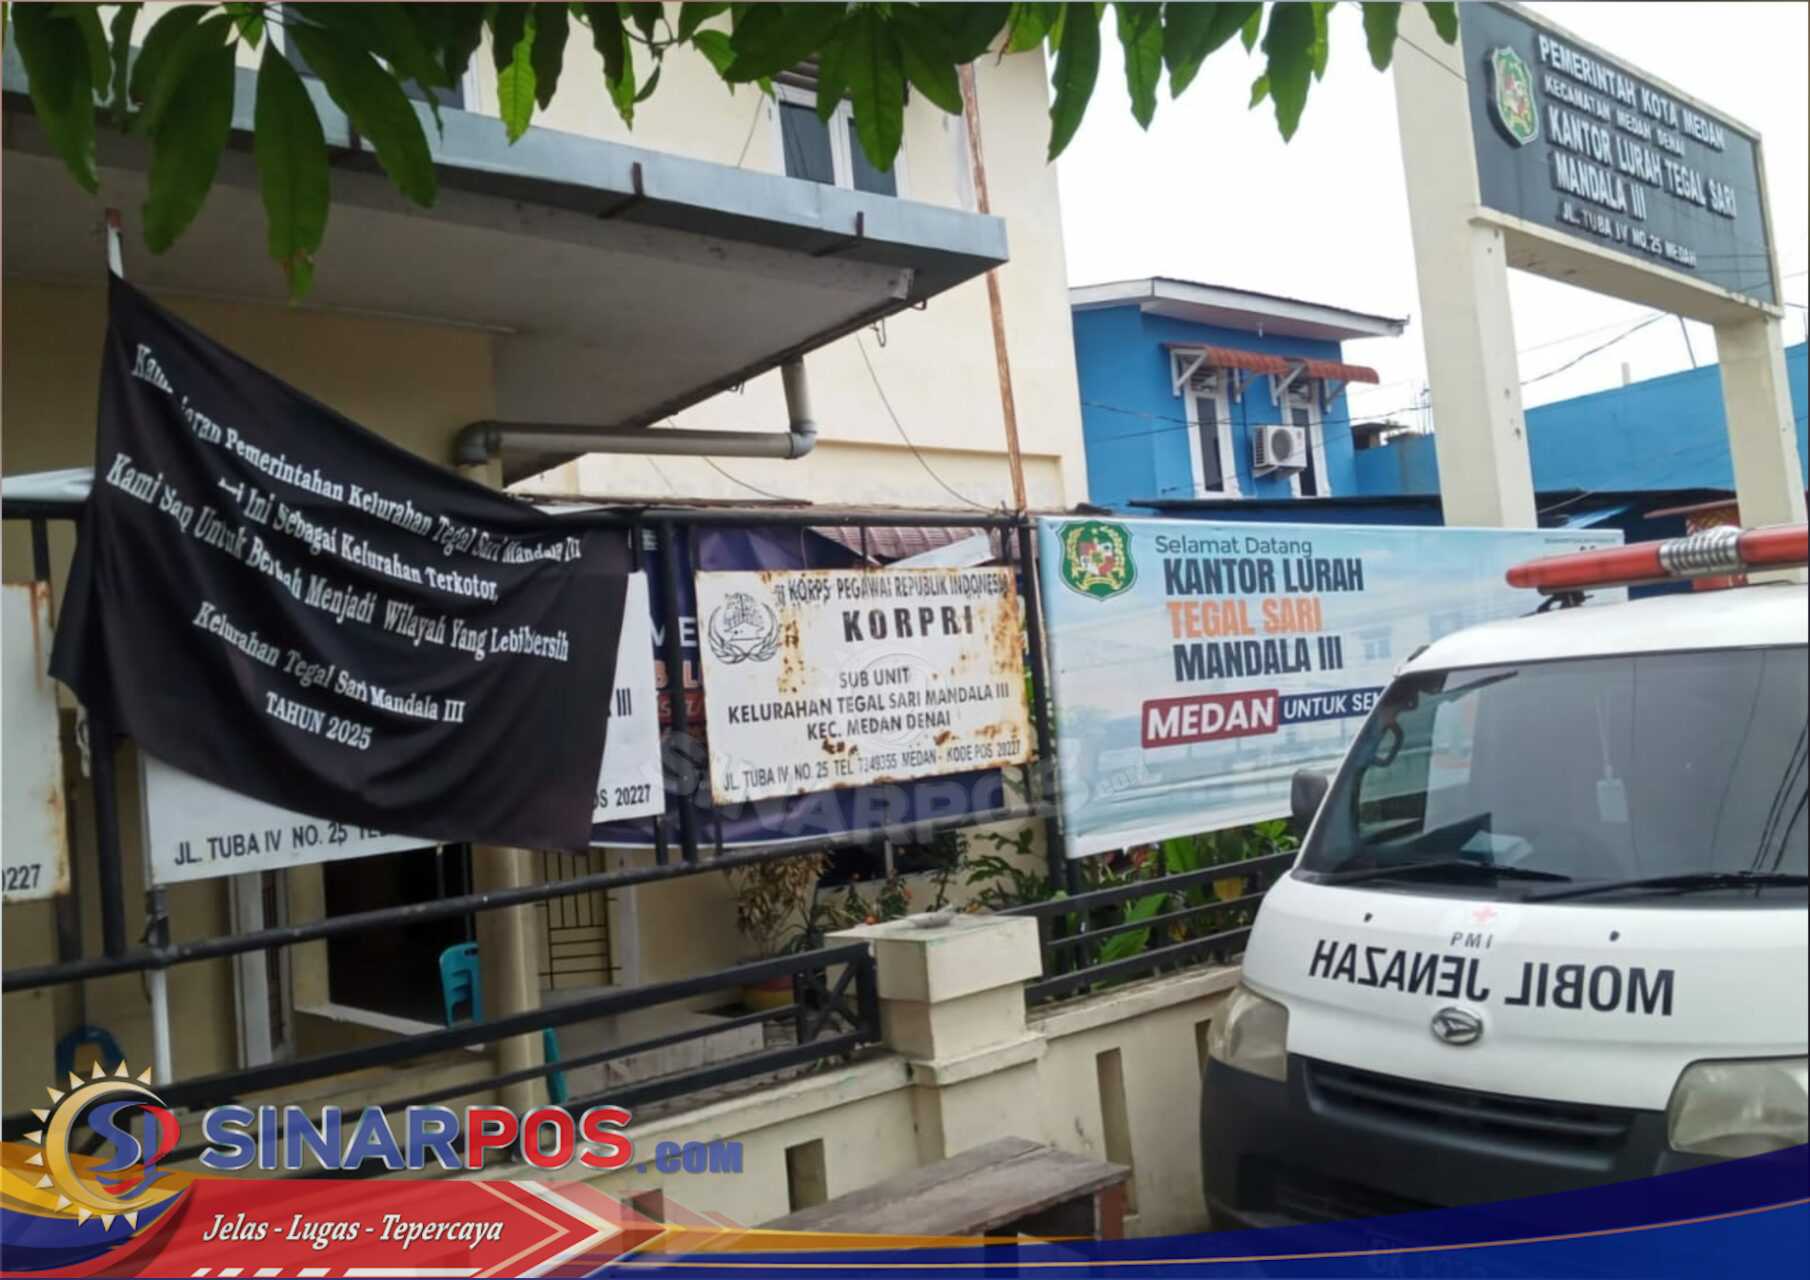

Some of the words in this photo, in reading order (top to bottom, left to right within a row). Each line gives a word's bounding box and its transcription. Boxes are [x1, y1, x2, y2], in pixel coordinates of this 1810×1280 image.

[1539, 34, 1636, 107] PEMERINTAH
[1640, 87, 1678, 129] KOTA
[1682, 109, 1725, 151] MEDAN
[1544, 75, 1611, 122] KECAMATAN
[1616, 110, 1650, 141] MEDAN
[1656, 128, 1685, 158] DENAI
[1549, 105, 1613, 167] KANTOR
[1616, 136, 1662, 188] LURAH
[1664, 159, 1706, 208] TEGAL
[1708, 178, 1736, 218] SARI
[1555, 152, 1627, 211] MANDALA
[1630, 183, 1647, 220] III
[1582, 210, 1612, 236] TUBA
[1650, 235, 1663, 255] 25
[1664, 241, 1696, 266] MEDAN
[225, 427, 344, 502] Pemerintahan
[348, 484, 434, 536] Kelurahan
[432, 516, 477, 556] Tegal
[106, 453, 164, 504] Kami
[304, 574, 378, 624] Menjadi
[383, 599, 447, 646] Wilayah
[450, 617, 488, 661] Yang
[244, 489, 275, 534] Ini
[272, 502, 338, 556] Sebagai
[341, 533, 423, 584] Kelurahan
[424, 566, 499, 604] Terkotor,
[1155, 536, 1240, 554] Selamat
[1246, 537, 1312, 559] Datang
[837, 577, 892, 601] PEGAWAI
[894, 575, 948, 597] REPUBLIK
[1163, 558, 1275, 595] KANTOR
[1283, 557, 1364, 593] LURAH
[842, 605, 974, 642] KORPRI
[1166, 598, 1255, 639] TEGAL
[1262, 596, 1323, 635] SARI
[193, 601, 280, 667] Kelurahan
[283, 649, 336, 688] Tegal
[369, 684, 439, 721] Mandala
[442, 700, 466, 723] III
[840, 671, 868, 688] SUB
[873, 667, 911, 686] UNIT
[1173, 637, 1311, 682] MANDALA
[1317, 635, 1343, 670] III
[266, 691, 324, 734] TAHUN
[326, 717, 373, 750] 2025
[616, 686, 632, 717] III
[728, 698, 833, 724] KELURAHAN
[837, 693, 885, 714] TEGAL
[889, 690, 921, 709] SARI
[924, 684, 993, 705] MANDALA
[996, 683, 1009, 699] III
[1147, 696, 1275, 740] MEDAN
[1284, 694, 1347, 719] UNTUK
[806, 722, 842, 741] KEC.
[846, 716, 902, 735] MEDAN
[907, 711, 951, 729] DENAI
[743, 768, 775, 788] TUBA
[777, 765, 789, 783] IV
[816, 760, 829, 779] 25
[902, 750, 937, 769] MEDAN
[947, 744, 974, 762] KODE
[977, 742, 994, 759] POS
[616, 784, 651, 807] 20227
[175, 841, 202, 865] JL.
[207, 834, 260, 860] TUBA
[265, 829, 283, 852] IV
[292, 824, 322, 849] NO.
[329, 822, 348, 846] 25
